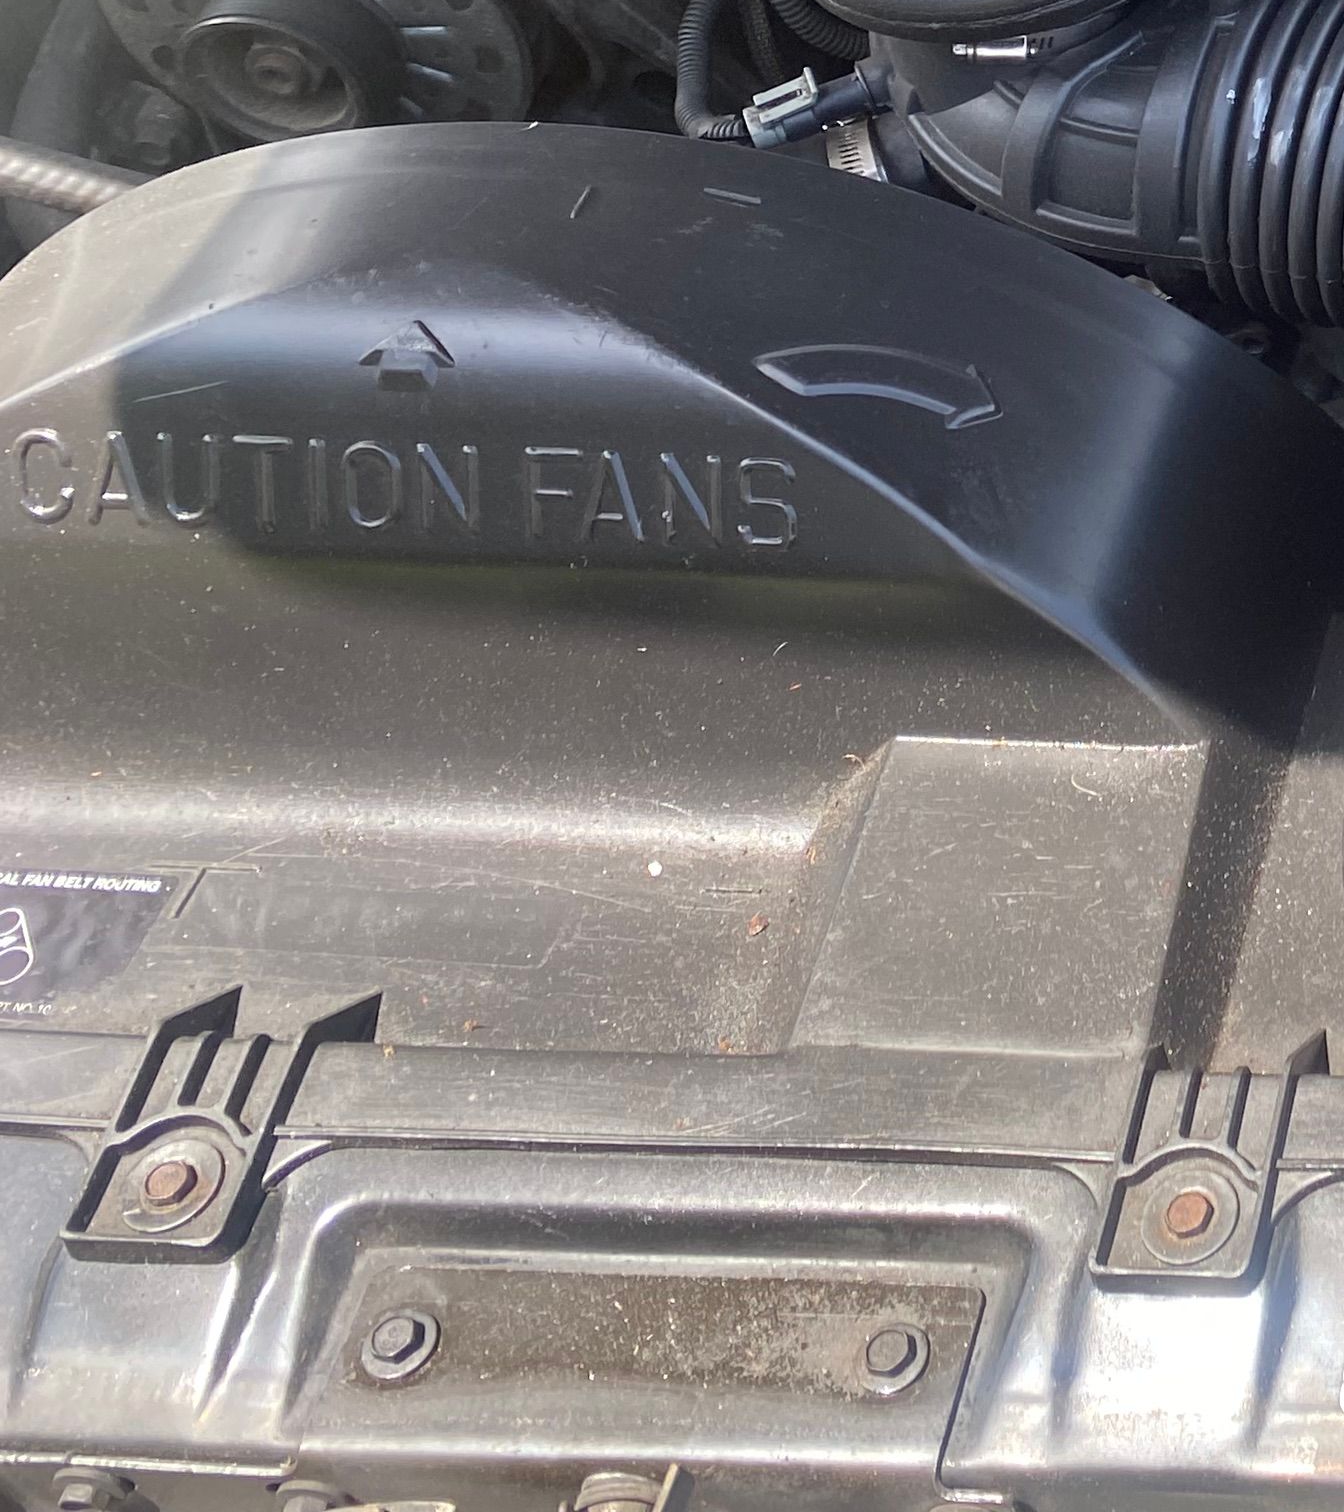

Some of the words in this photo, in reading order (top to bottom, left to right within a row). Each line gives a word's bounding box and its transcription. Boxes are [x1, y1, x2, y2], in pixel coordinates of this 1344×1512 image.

[10, 426, 481, 534] CAUTION
[524, 444, 799, 550] FANS
[21, 873, 55, 887] FAN
[53, 875, 94, 889] BELT
[92, 876, 162, 893] ROUTING
